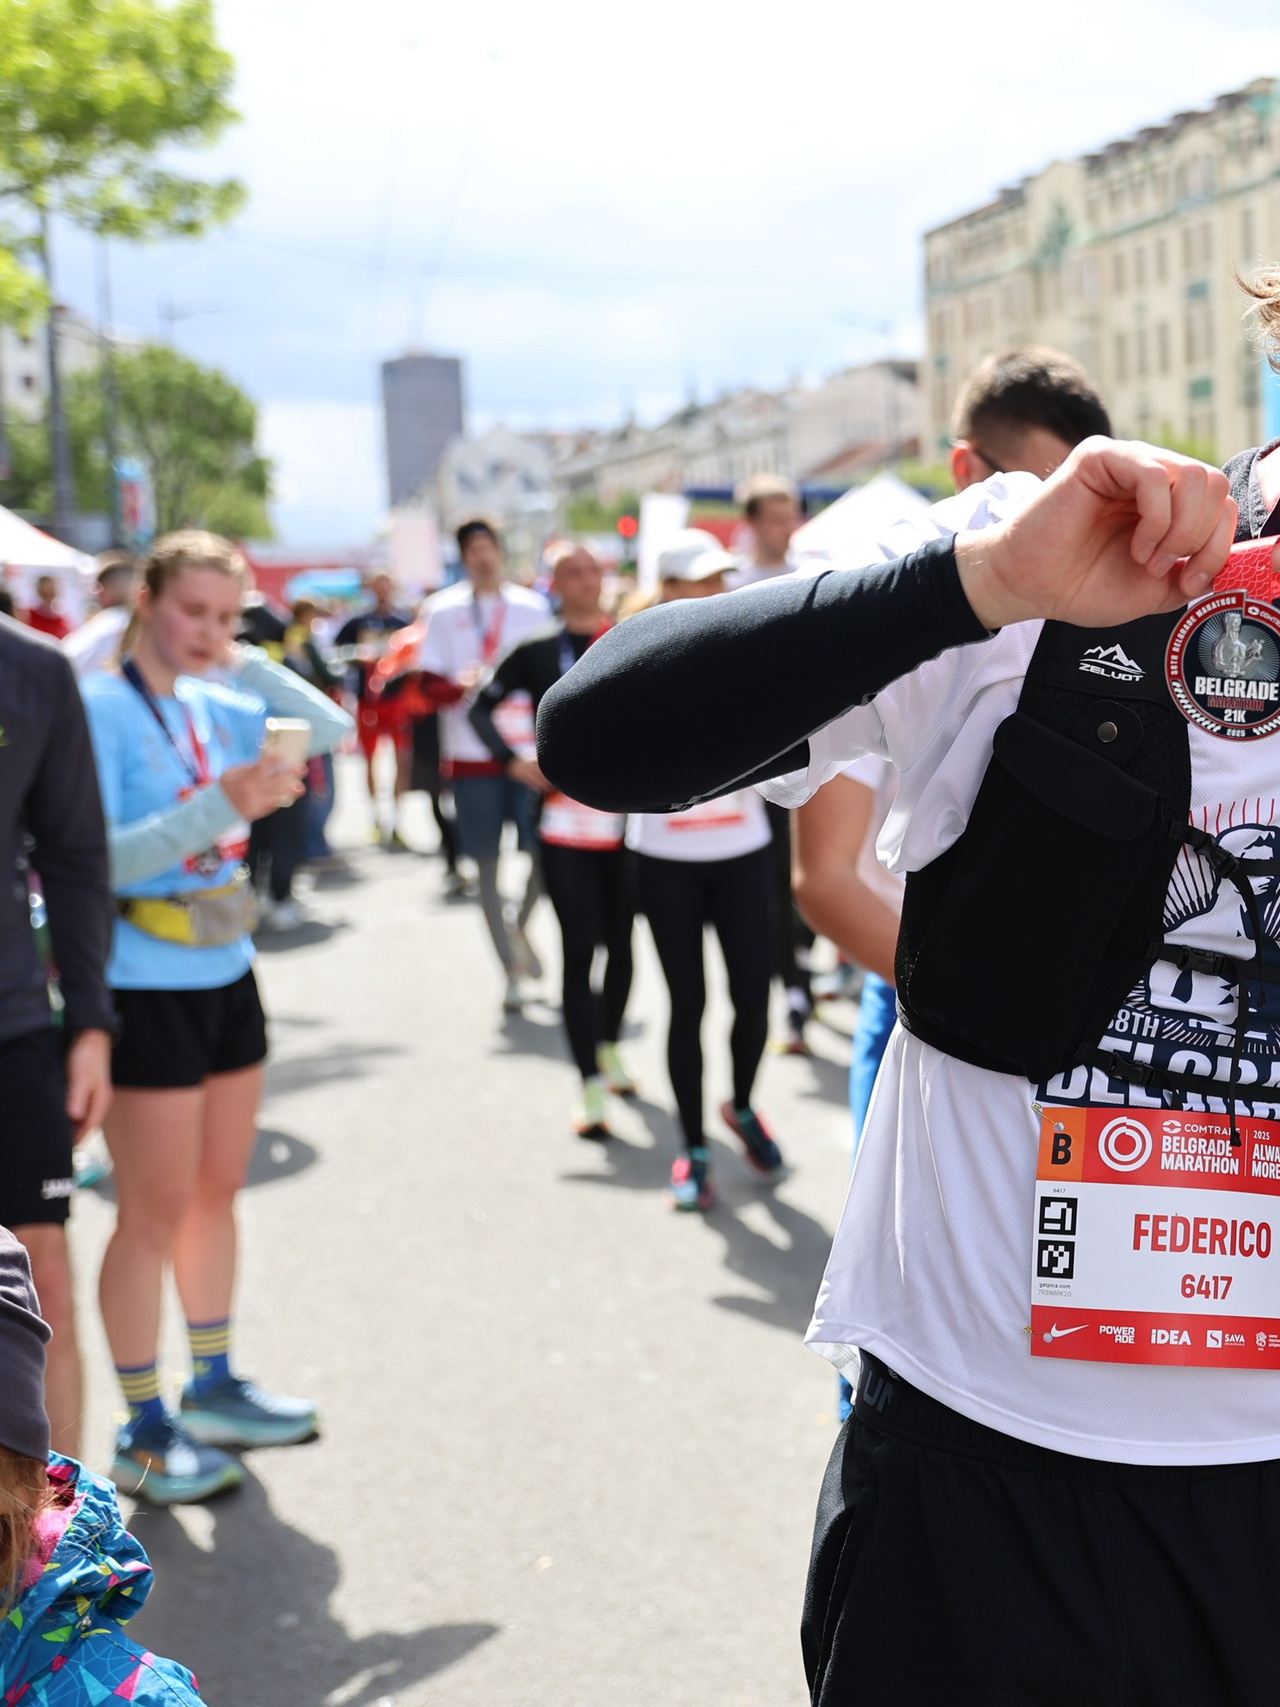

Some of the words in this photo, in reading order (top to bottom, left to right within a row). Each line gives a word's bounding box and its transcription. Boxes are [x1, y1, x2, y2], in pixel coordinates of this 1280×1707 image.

[1172, 616, 1197, 653] BELGRADE
[1195, 596, 1237, 618] MARATHON
[1195, 676, 1280, 702] BELGRADE
[1223, 708, 1247, 723] 21K
[1226, 728, 1246, 738] 2025
[1253, 1130, 1271, 1141] 2025
[1050, 1132, 1073, 1166] B
[1161, 1136, 1233, 1157] BELGRADE
[1161, 1153, 1240, 1175] MARATHON
[1132, 1212, 1273, 1260] FEDERICO
[1181, 1273, 1233, 1301] 6417
[1099, 1325, 1136, 1336] POWER
[1114, 1334, 1136, 1344] ADE
[1224, 1333, 1246, 1343] SAVA
